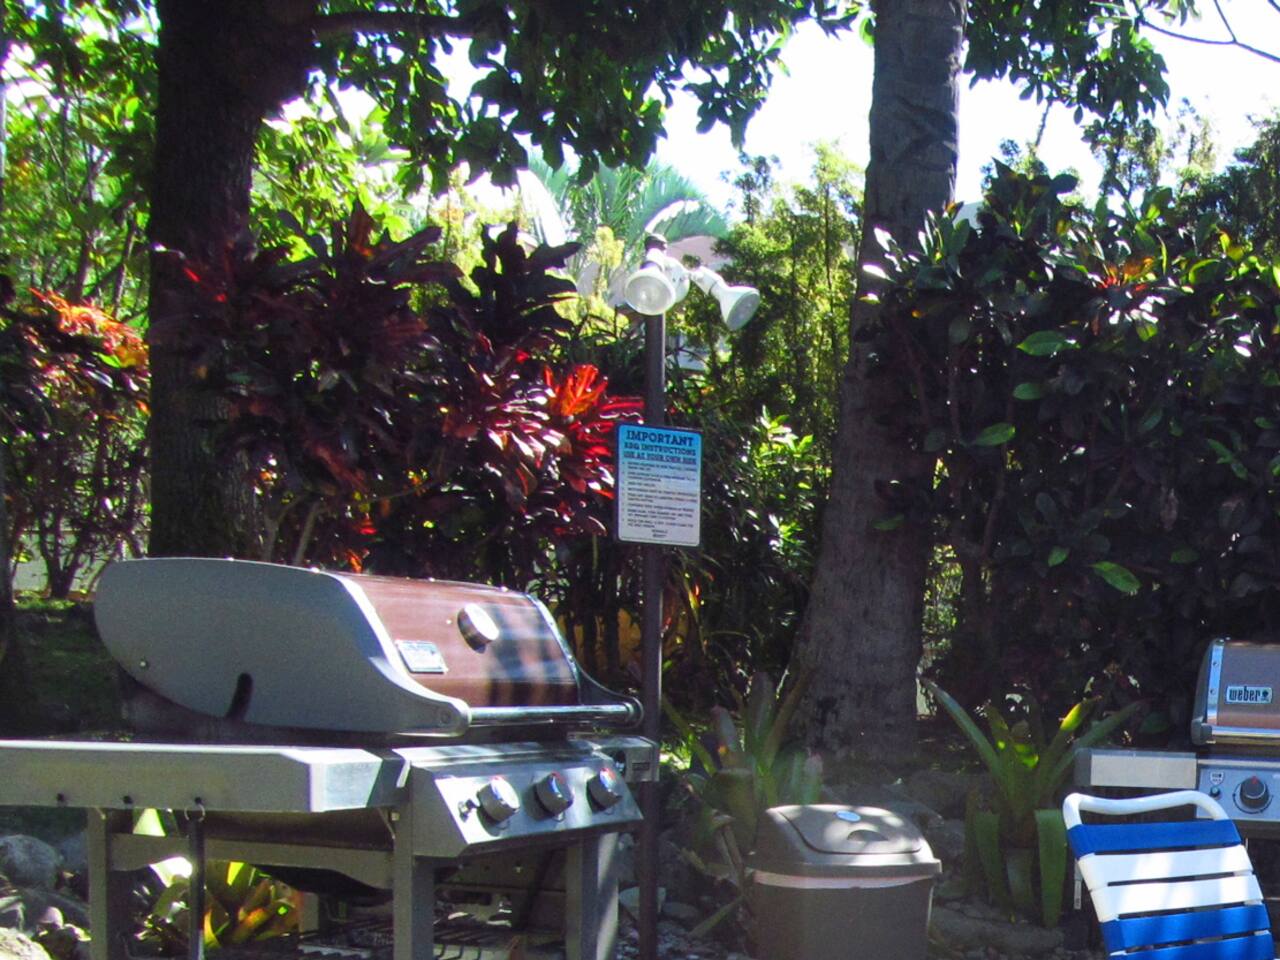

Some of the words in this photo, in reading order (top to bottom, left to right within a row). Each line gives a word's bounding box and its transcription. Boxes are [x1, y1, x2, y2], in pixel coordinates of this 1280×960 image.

[626, 430, 694, 447] IMPORTANT
[641, 444, 697, 457] INSTRUCTIONS
[1229, 686, 1261, 702] weber
